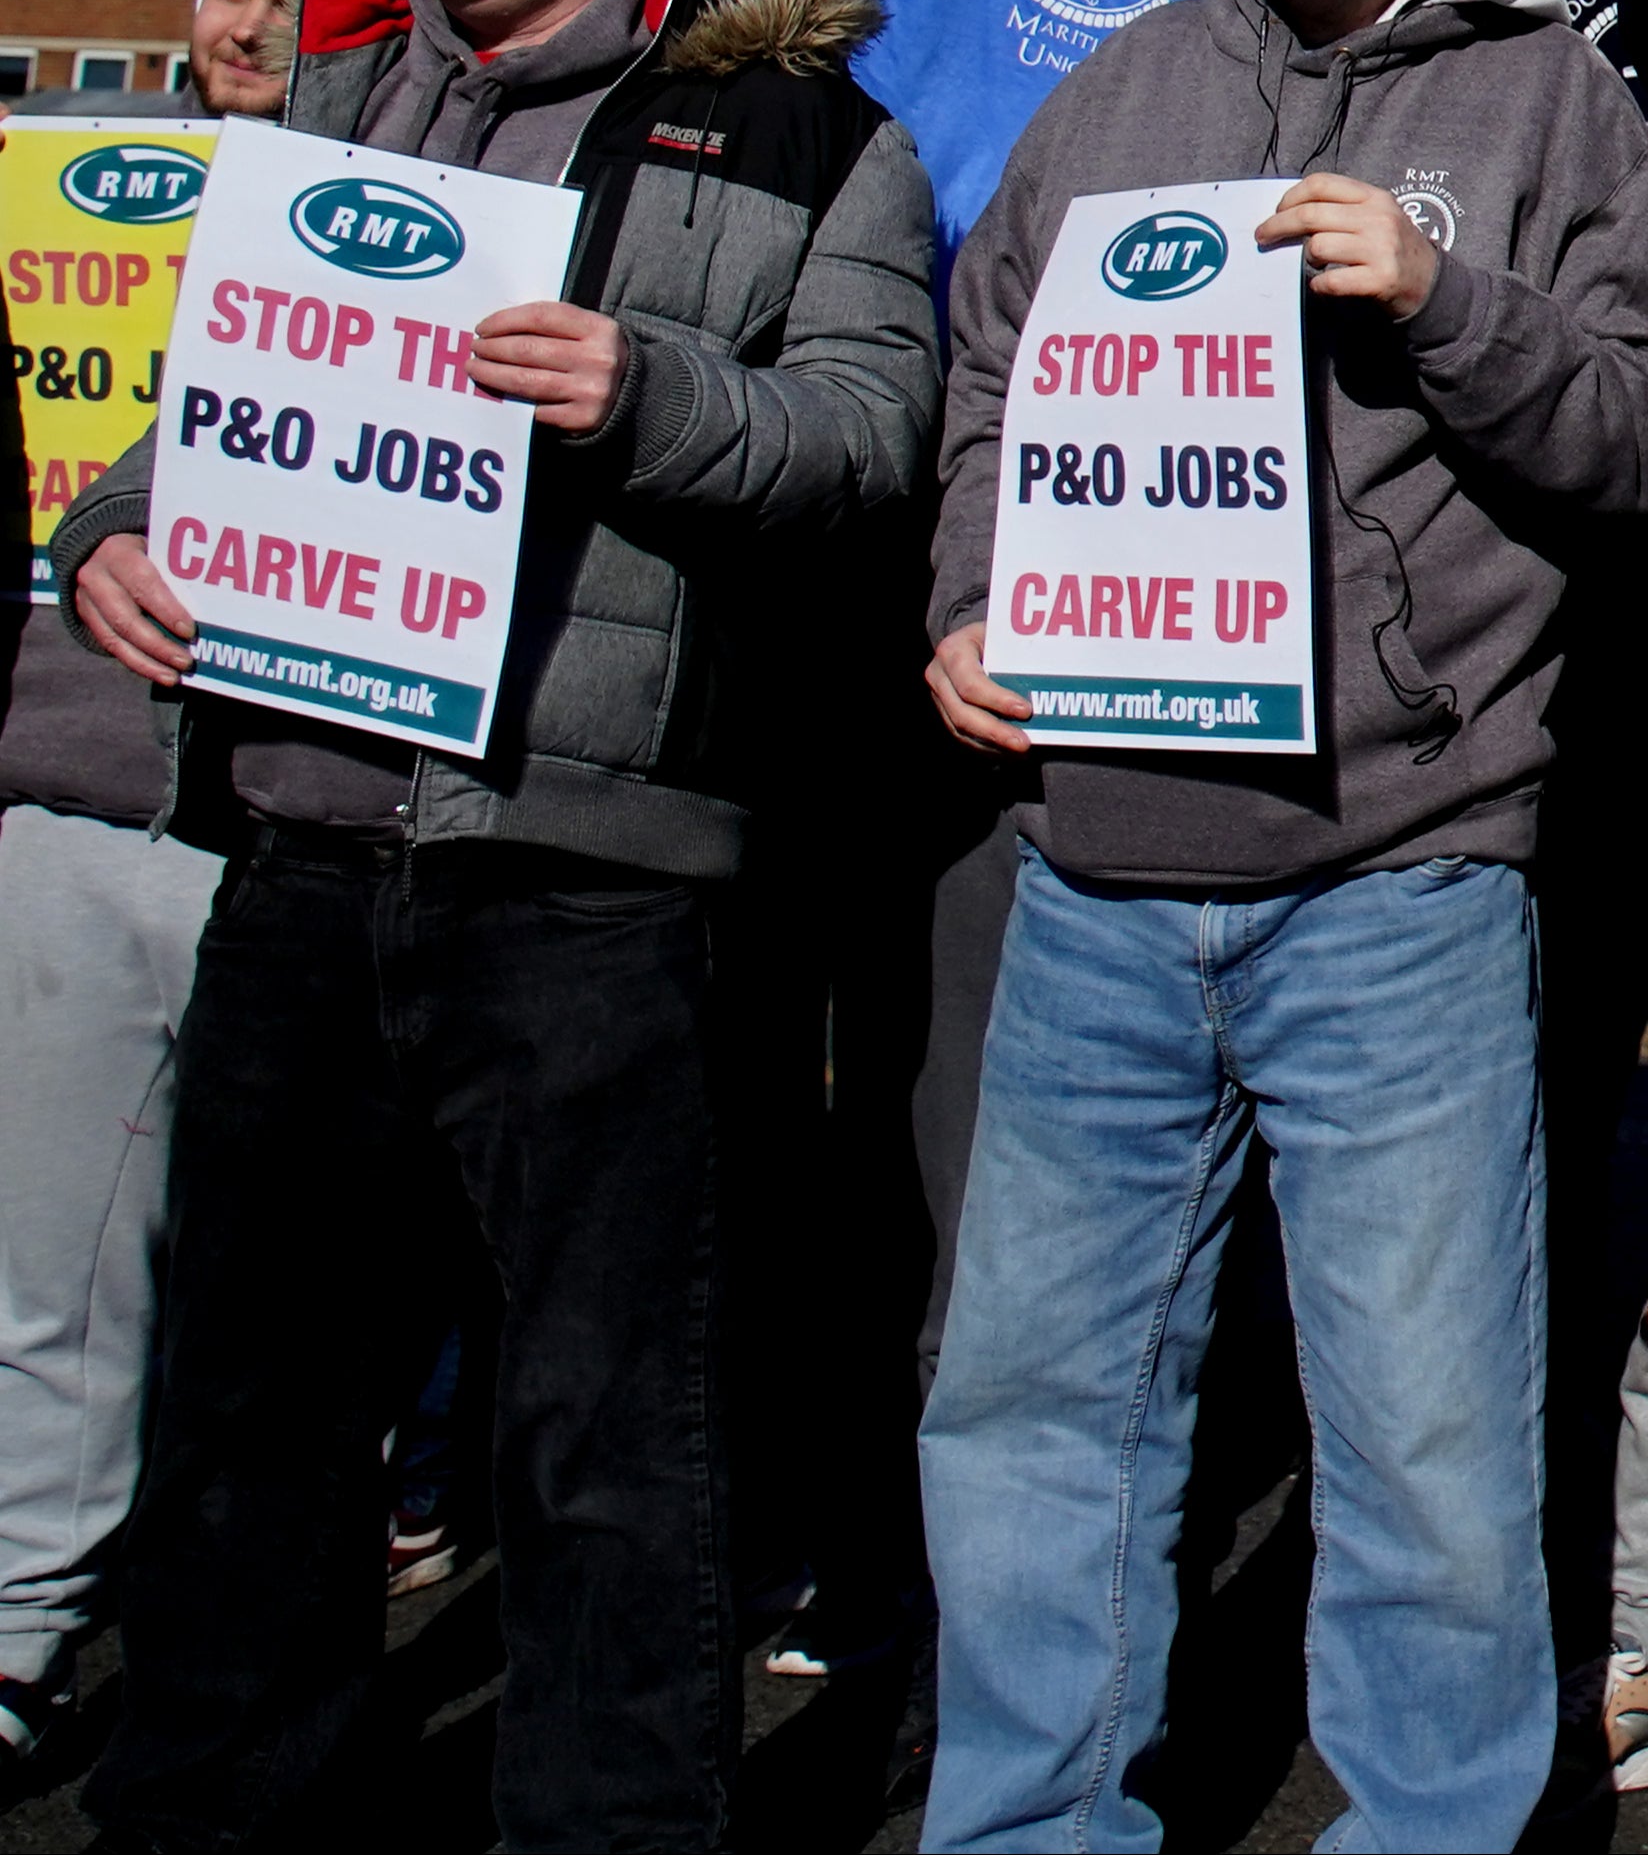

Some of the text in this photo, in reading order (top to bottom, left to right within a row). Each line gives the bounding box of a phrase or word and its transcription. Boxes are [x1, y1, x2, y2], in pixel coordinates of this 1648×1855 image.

[1006, 4, 1099, 54] MARITI
[1018, 36, 1080, 74] UNI
[97, 170, 188, 201] RMT
[1391, 182, 1465, 217] VER SHIPPING
[1406, 168, 1449, 183] RMT
[326, 209, 433, 256] RMT
[1126, 239, 1203, 274] RMT
[8, 249, 150, 307] STOP
[208, 278, 504, 403] STOP TH
[1033, 333, 1275, 398] STOP THE
[180, 386, 506, 514] P&O JOBS
[1018, 443, 1288, 510] P&O JOBS
[168, 516, 487, 642] CARVE UP
[1010, 572, 1289, 644] CARVE UP
[190, 636, 439, 718] www.rmt.org.uk
[1031, 688, 1262, 729] www.rmt.org.uk
